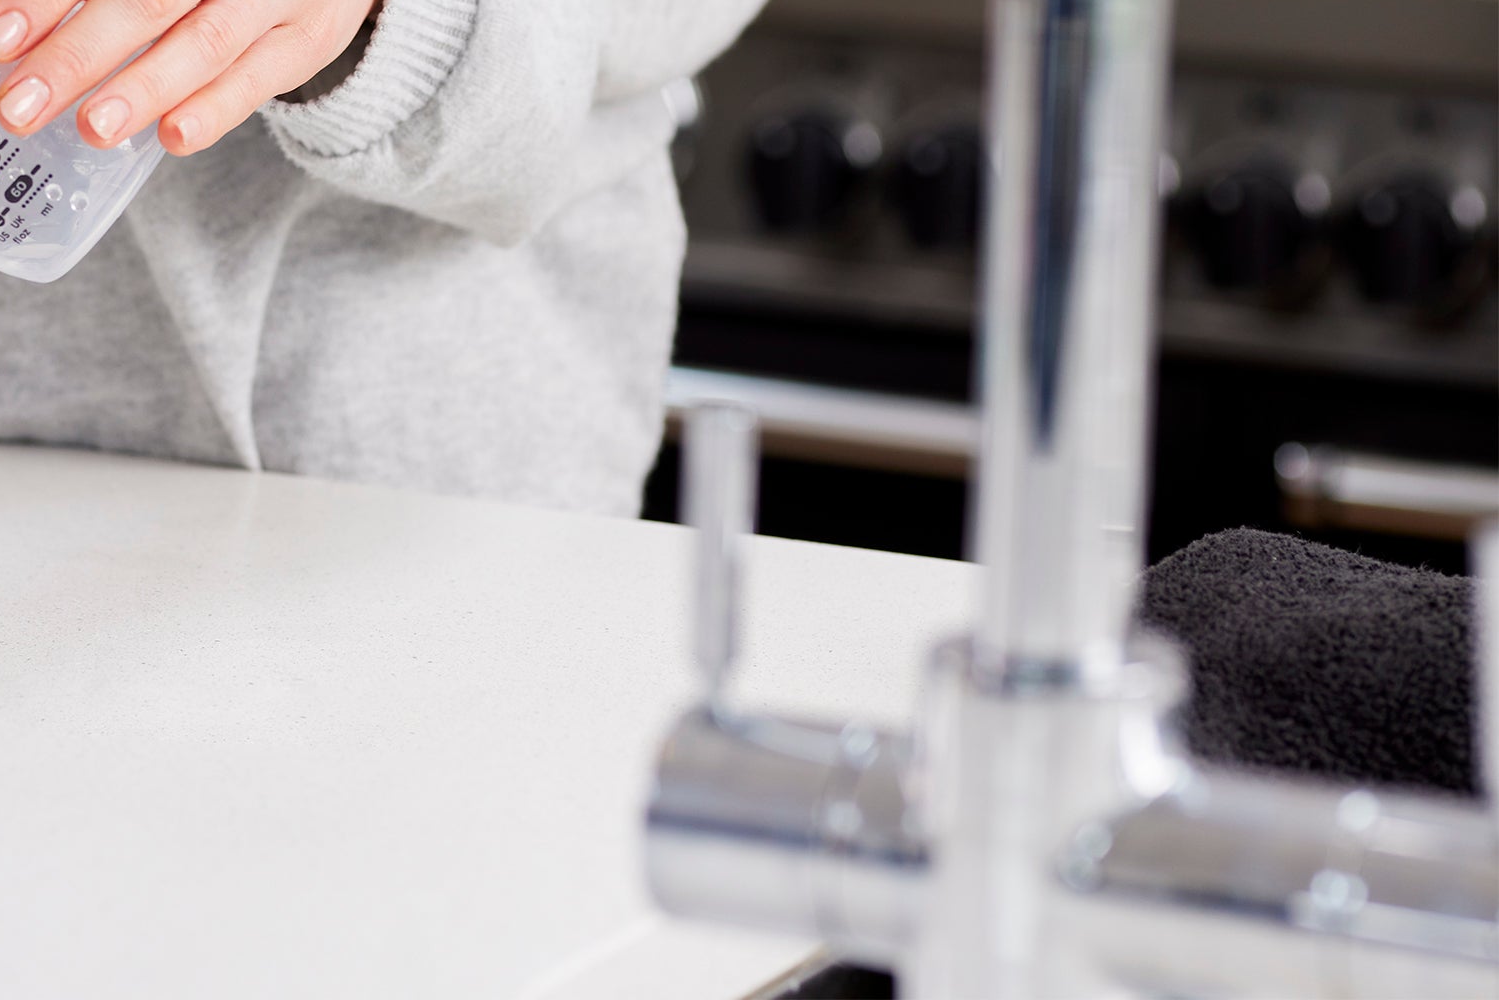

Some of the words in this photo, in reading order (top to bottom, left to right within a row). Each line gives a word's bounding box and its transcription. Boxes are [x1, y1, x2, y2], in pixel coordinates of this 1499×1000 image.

[9, 180, 29, 199] 60
[41, 202, 54, 217] ml
[10, 216, 25, 229] UK
